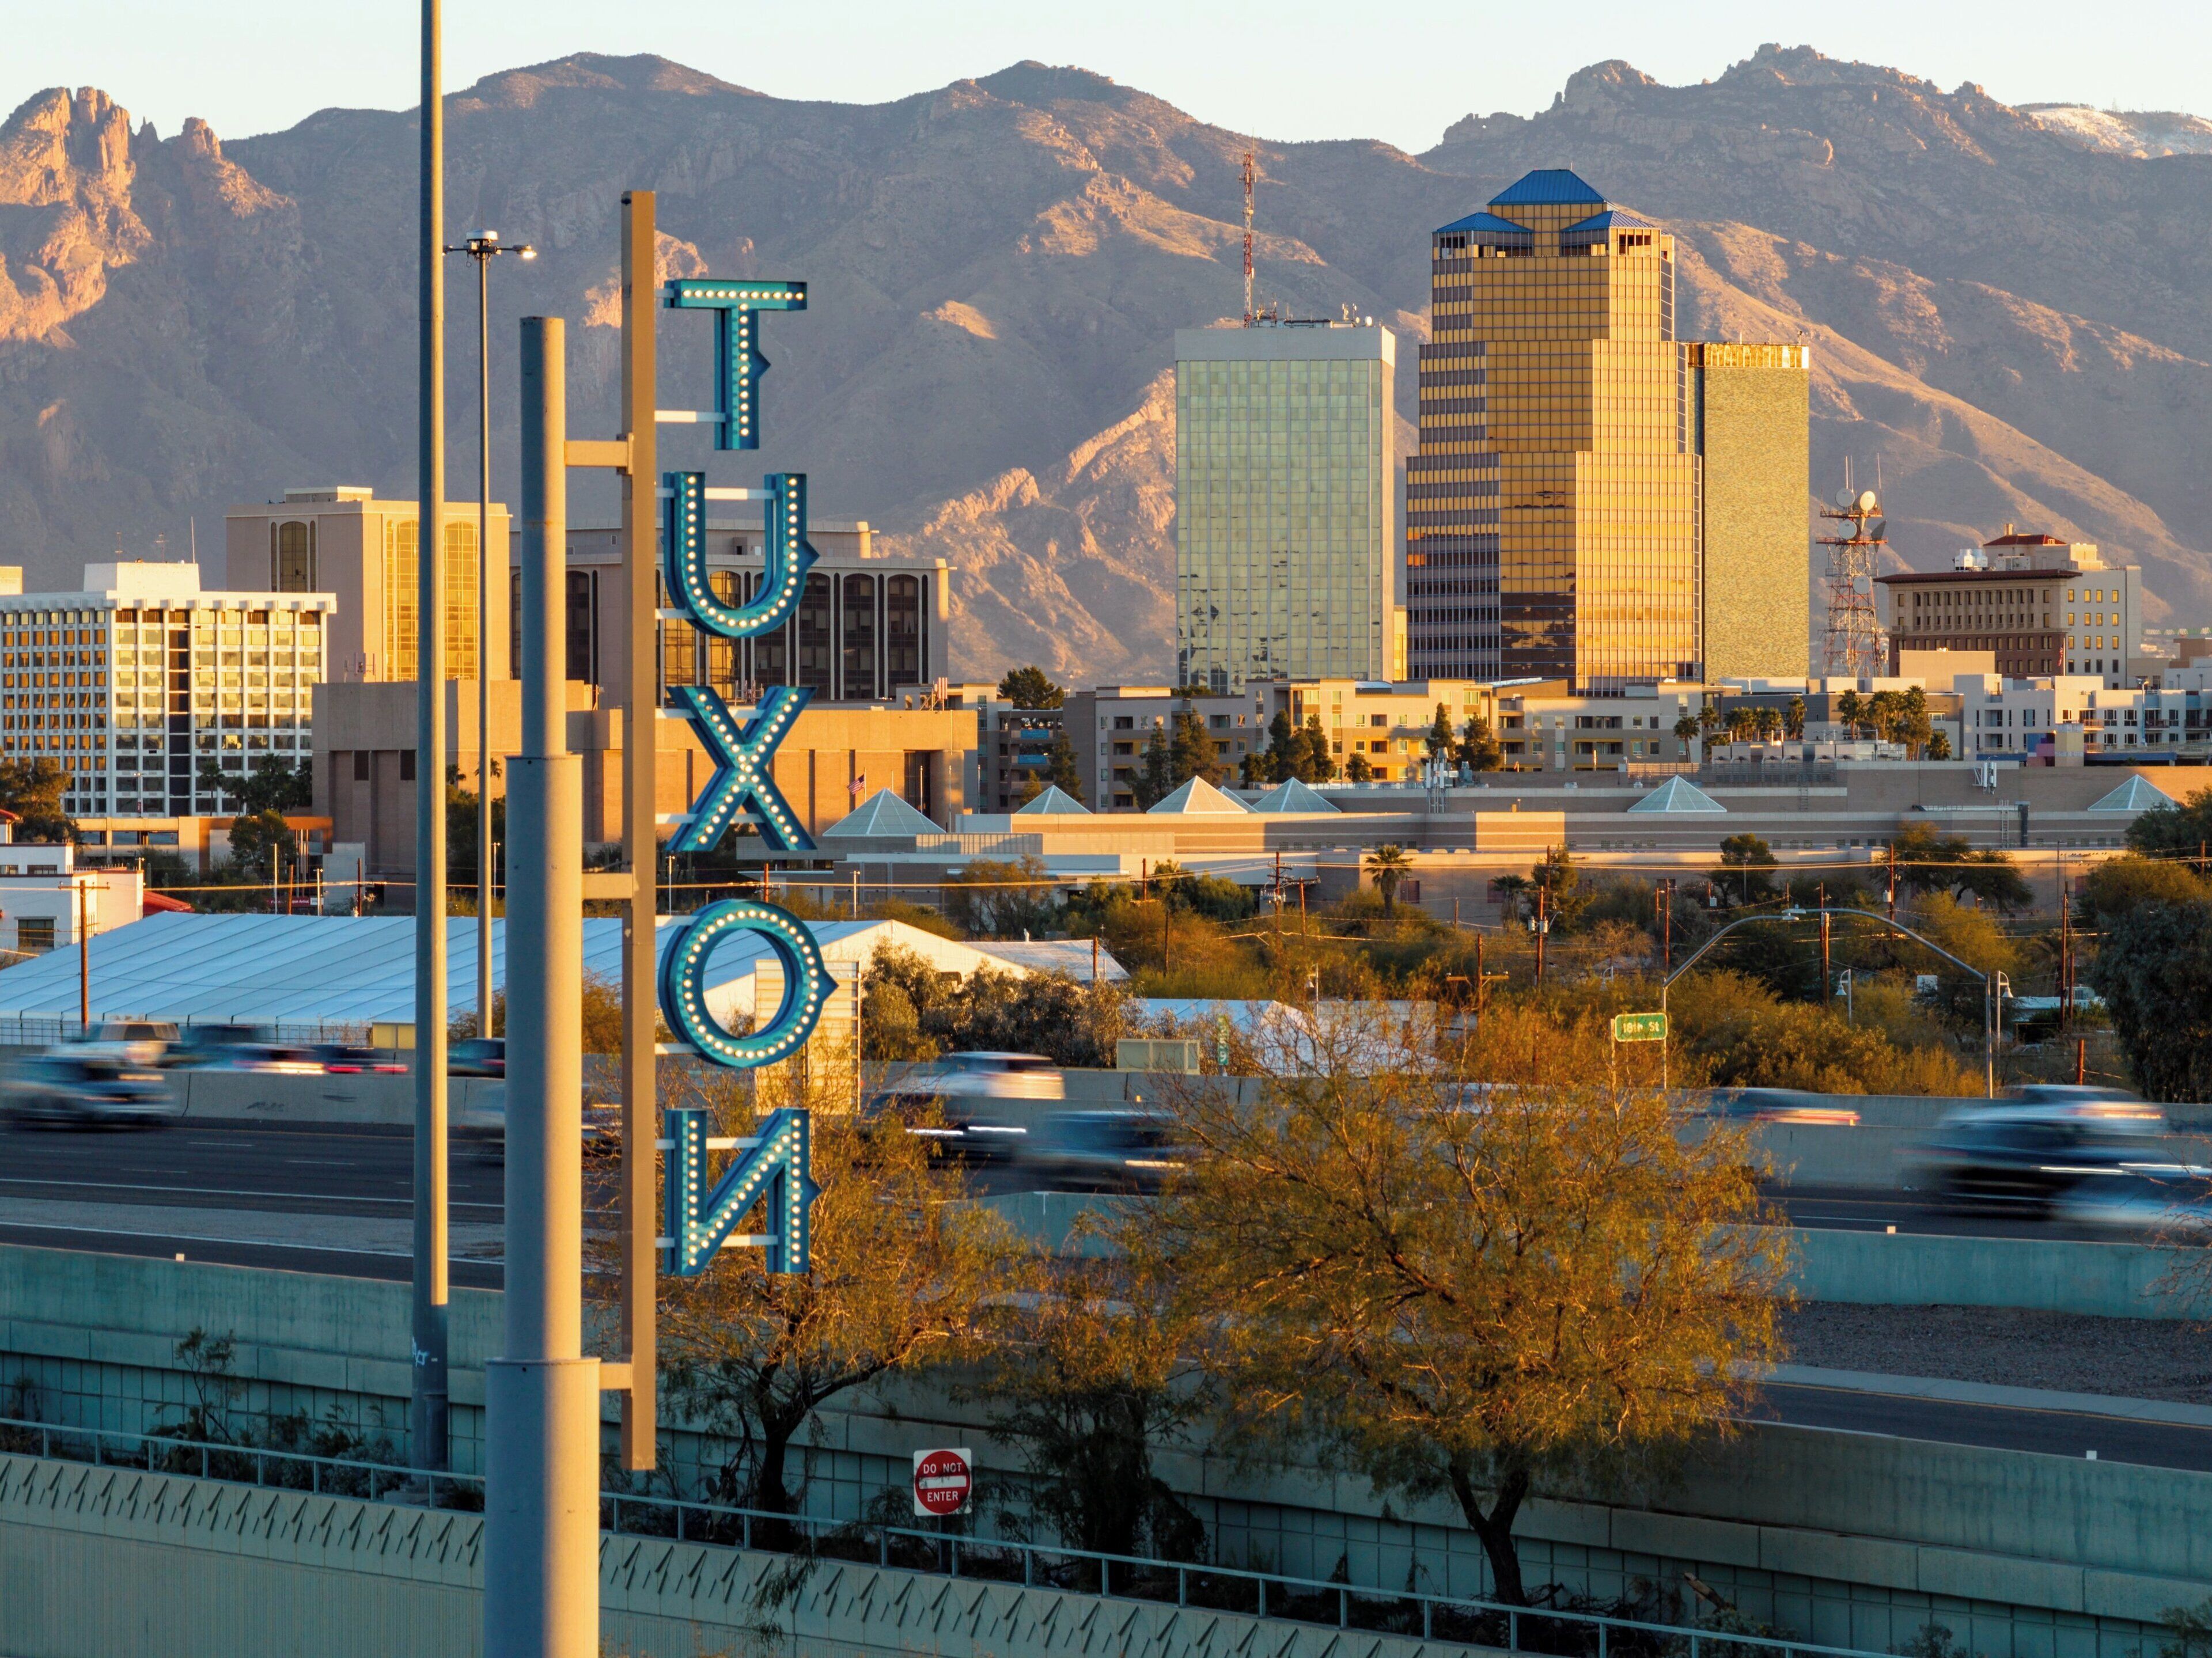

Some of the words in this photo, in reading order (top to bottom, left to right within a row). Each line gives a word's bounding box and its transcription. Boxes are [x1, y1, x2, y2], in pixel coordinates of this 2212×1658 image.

[1623, 1021, 1643, 1033] 18th
[1649, 1021, 1660, 1032] St
[923, 1463, 937, 1474] DO
[943, 1462, 962, 1473] NOT
[927, 1491, 959, 1502] ENTER
